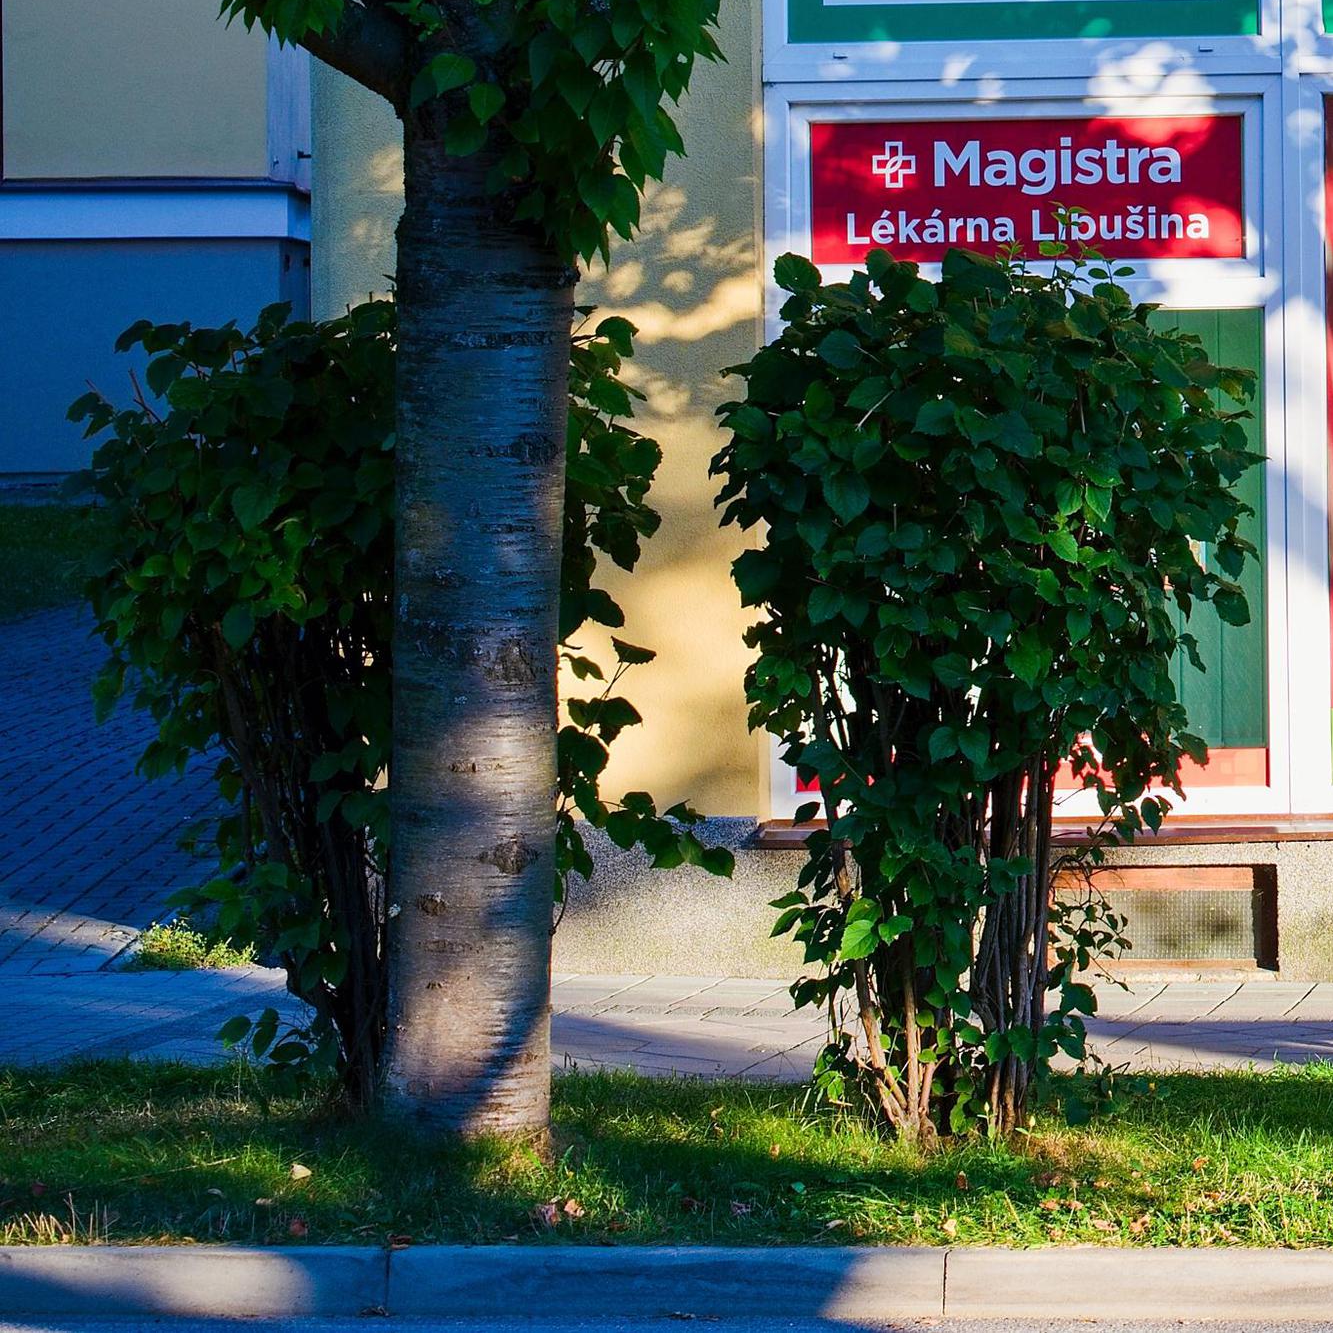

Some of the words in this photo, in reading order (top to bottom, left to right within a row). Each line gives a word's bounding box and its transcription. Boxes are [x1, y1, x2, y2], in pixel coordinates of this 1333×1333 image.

[933, 136, 1183, 196] Magistra
[846, 208, 1015, 246] Lékárna
[1031, 205, 1210, 242] Libušina
